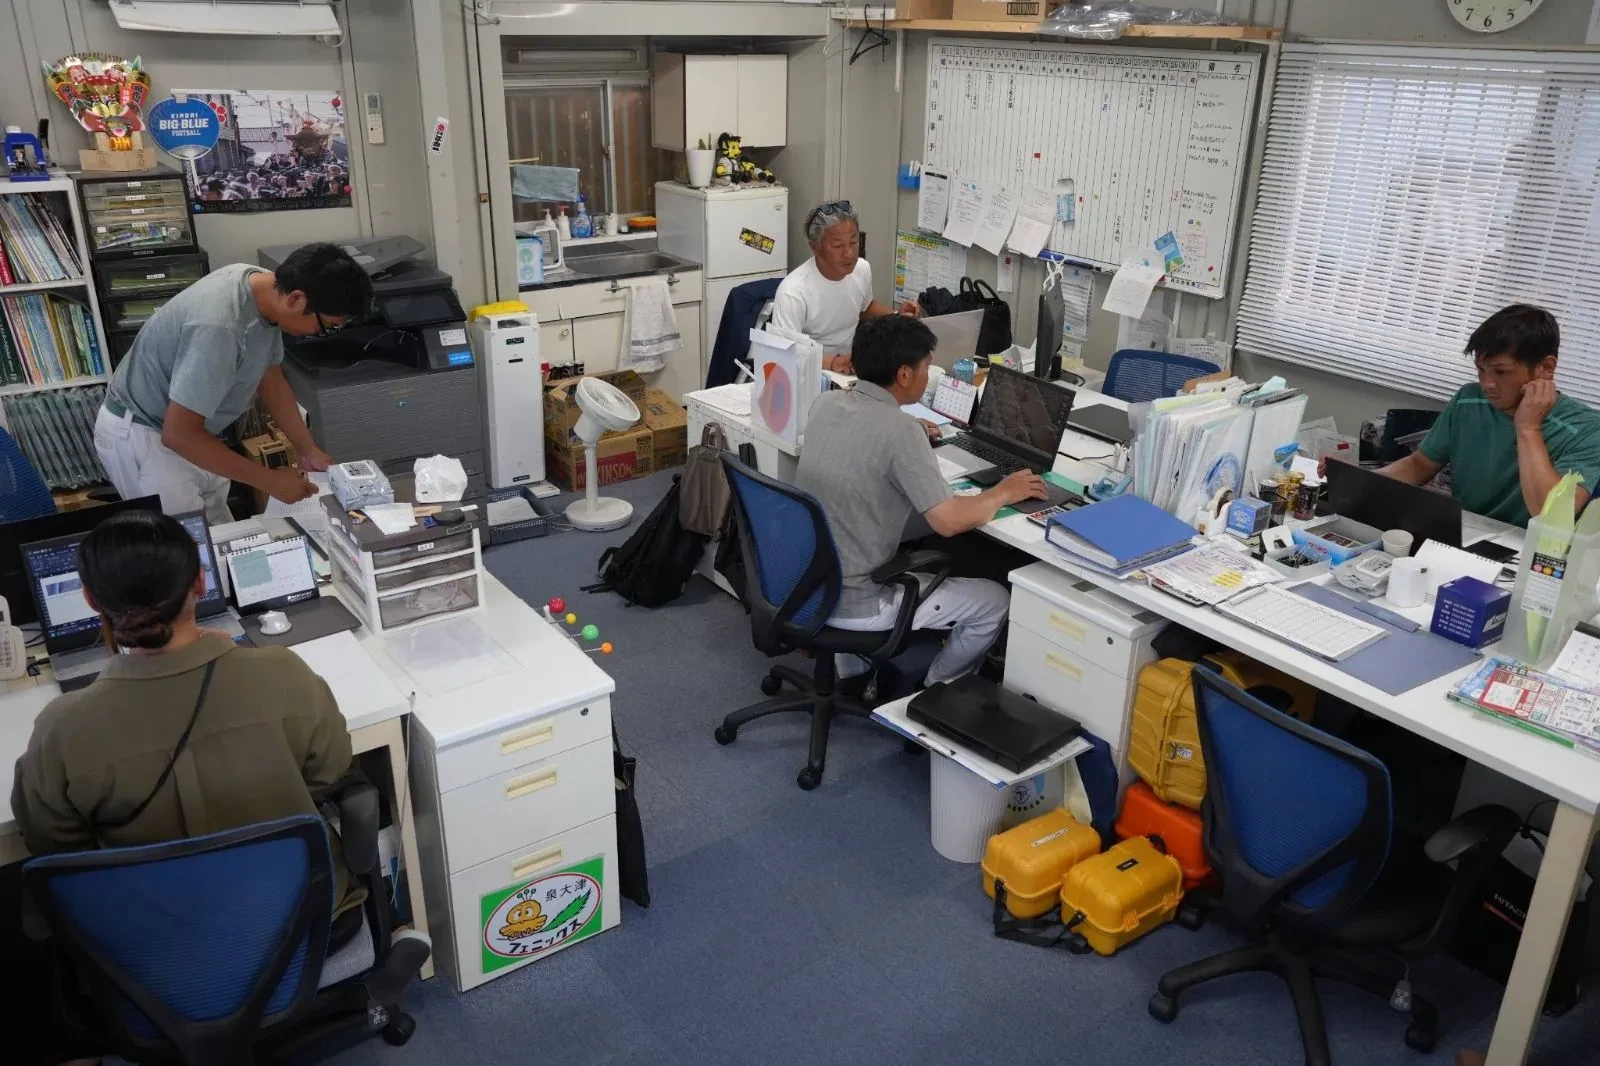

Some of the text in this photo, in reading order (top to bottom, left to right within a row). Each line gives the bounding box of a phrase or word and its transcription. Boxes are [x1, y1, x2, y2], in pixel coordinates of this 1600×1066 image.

[1465, 8, 1474, 21] 7
[1484, 15, 1492, 27] 6
[1506, 9, 1514, 21] 5
[160, 118, 208, 130] BIG BLUE
[577, 463, 632, 488] WKINSON
[545, 879, 587, 902] 泉大津
[509, 918, 582, 954] フェニックス
